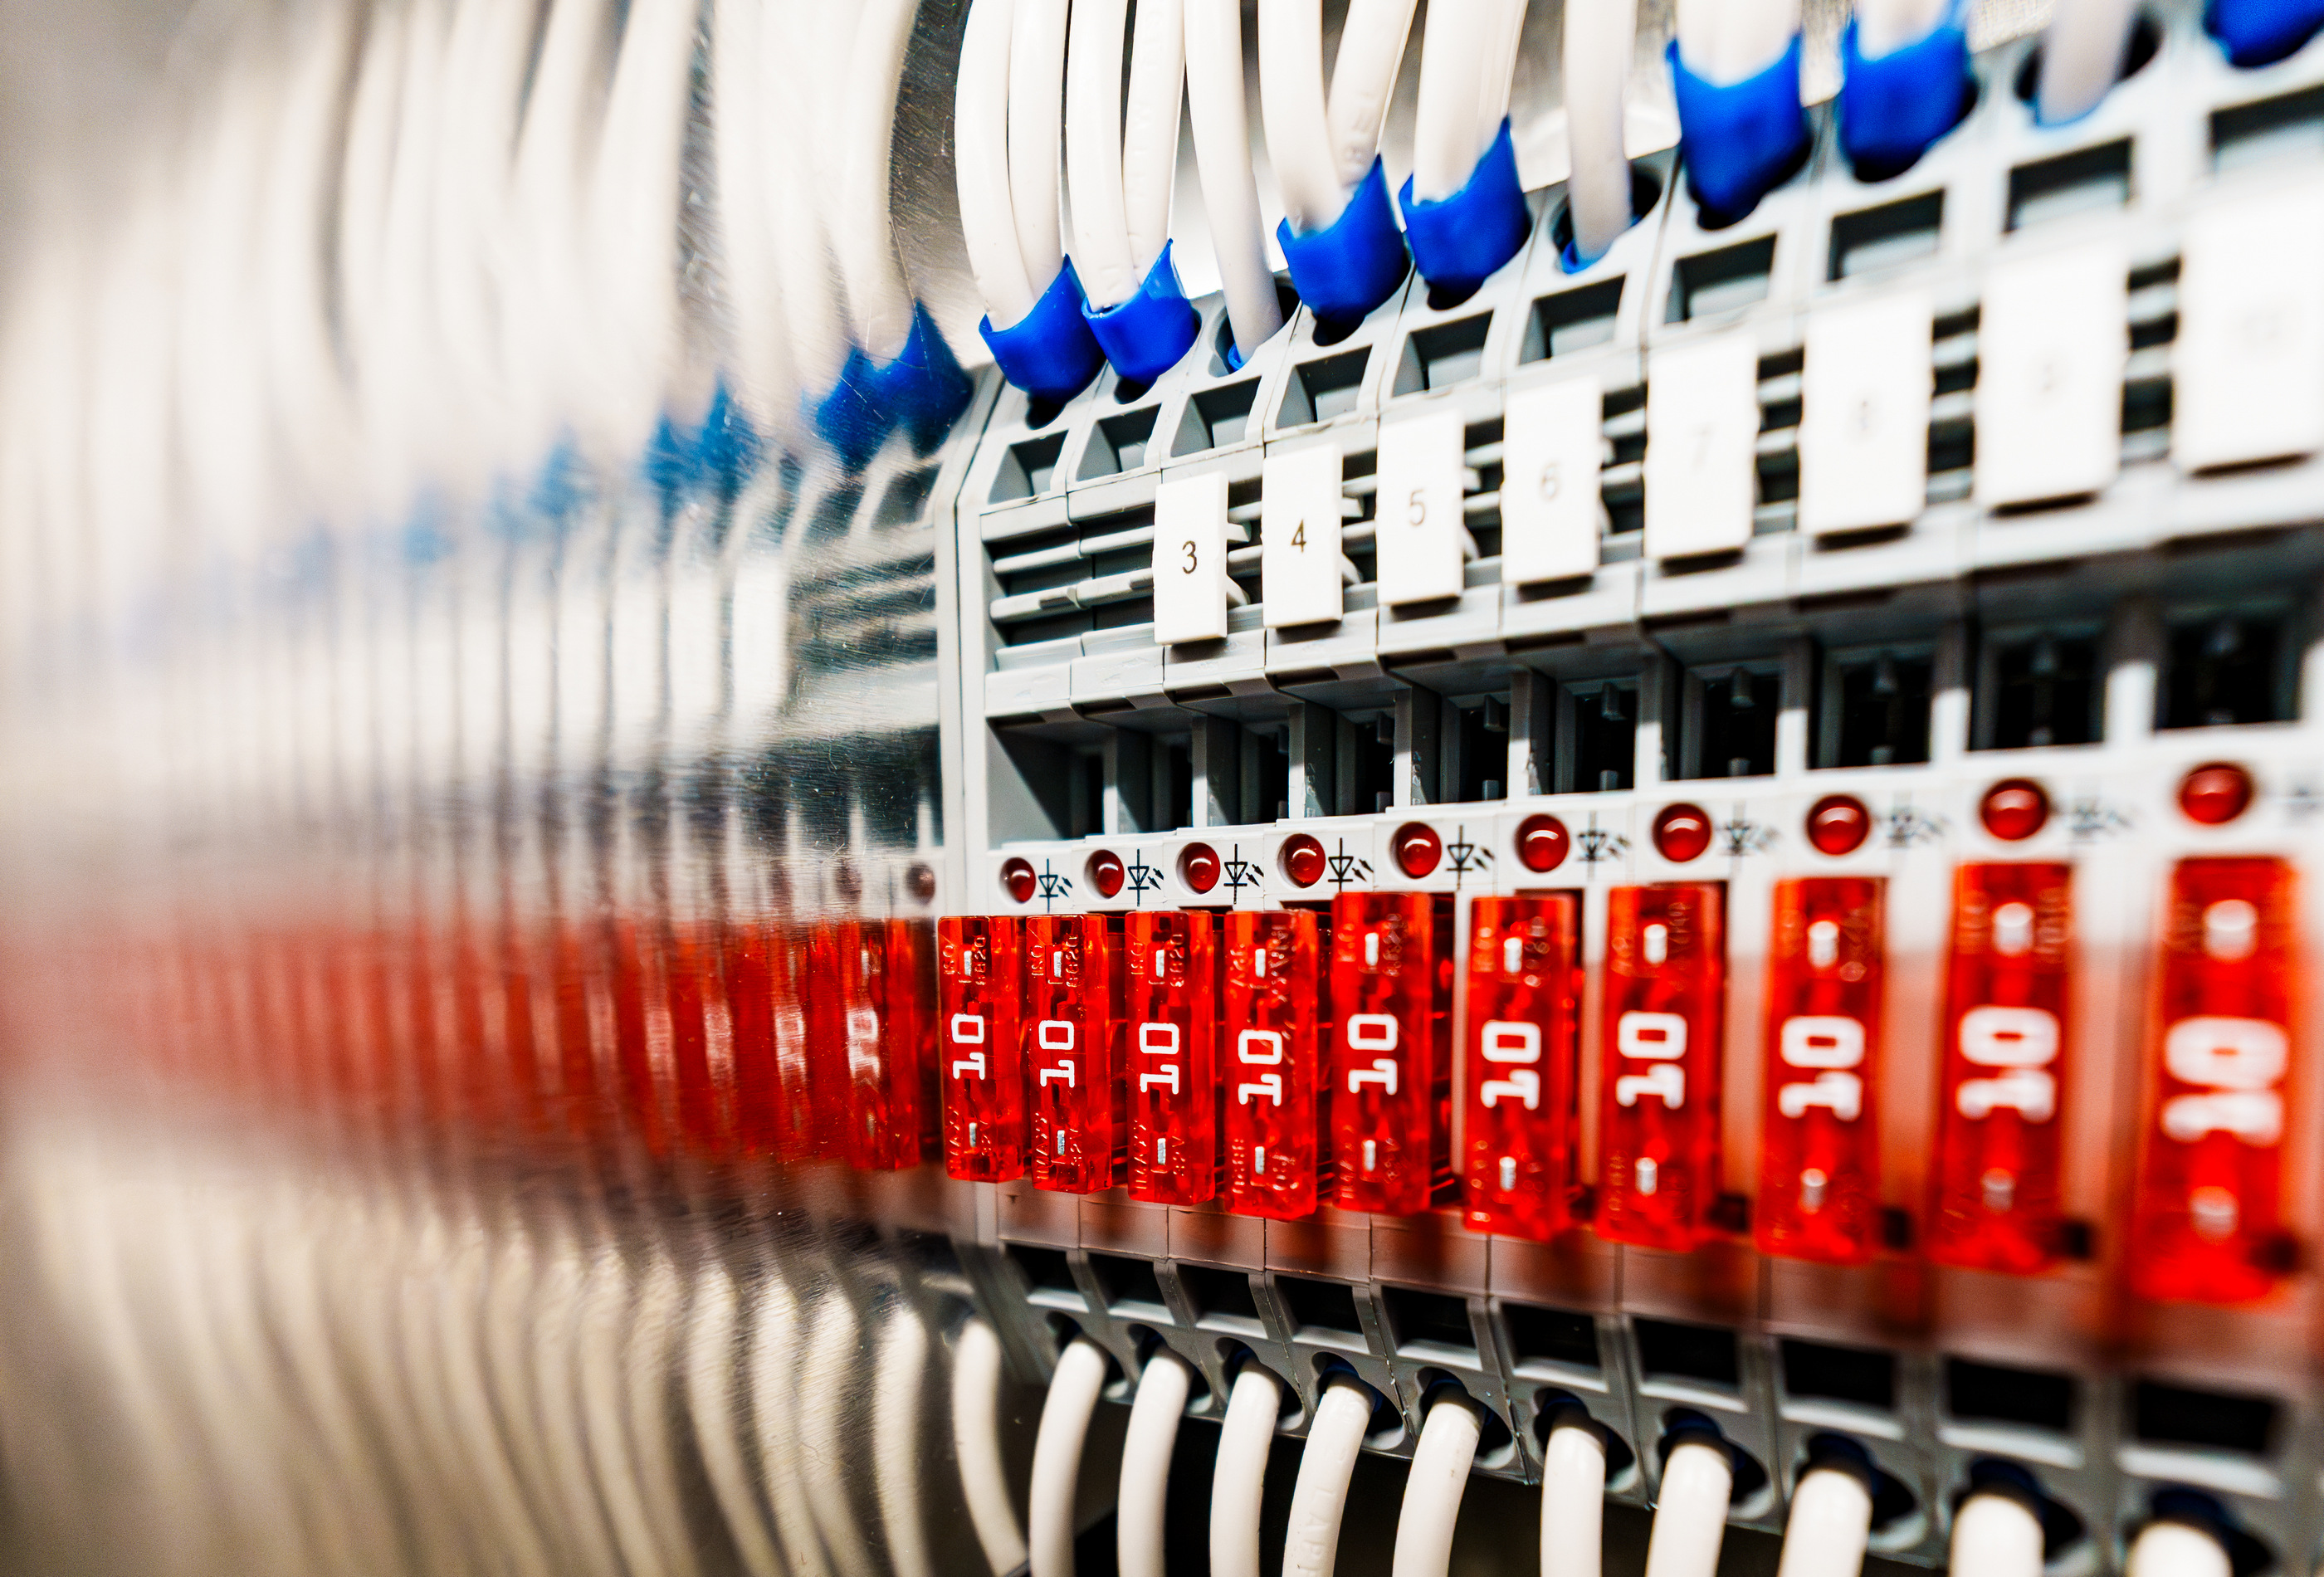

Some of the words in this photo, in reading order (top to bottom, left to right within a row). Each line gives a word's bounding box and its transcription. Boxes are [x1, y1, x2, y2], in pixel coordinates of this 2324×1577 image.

[1409, 488, 1426, 526] 5
[1540, 461, 1561, 500] 6
[1182, 540, 1198, 574] 3
[1291, 519, 1306, 554] 4
[950, 1013, 986, 1081] 10
[1038, 1019, 1076, 1088] 10
[1138, 1022, 1180, 1095] 10
[1238, 1028, 1283, 1106] 10
[1347, 1013, 1399, 1096] 10
[1481, 1020, 1542, 1111] 10
[1616, 1011, 1688, 1110] 10
[1779, 1015, 1865, 1120] 10
[1956, 1006, 2058, 1120] 10
[2161, 1016, 2289, 1143] 10
